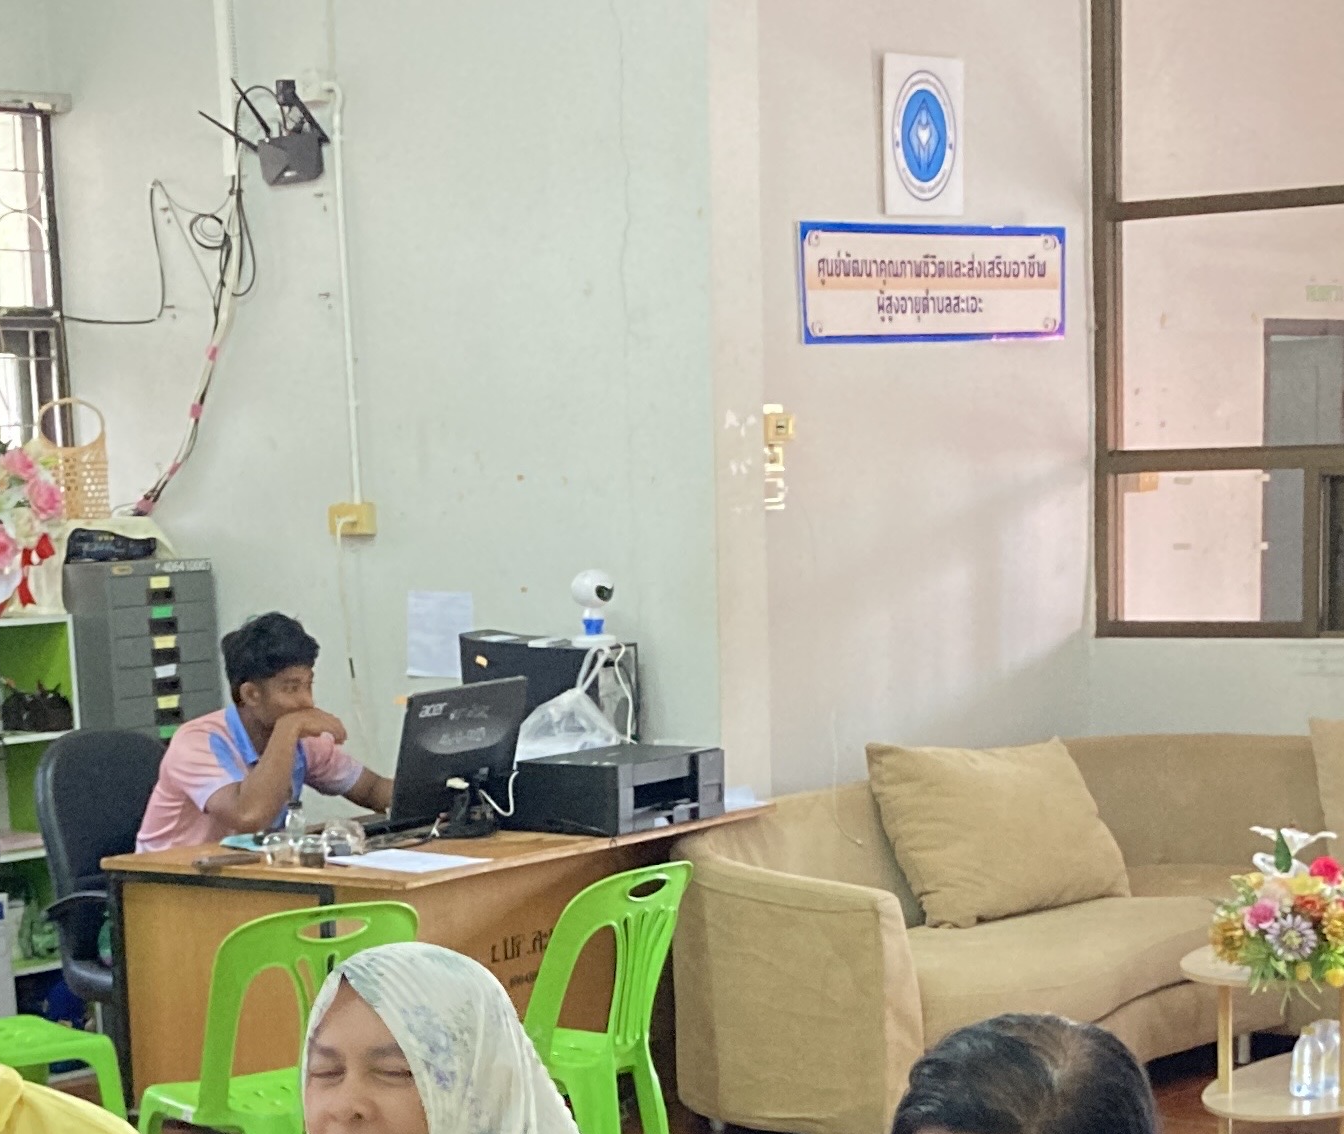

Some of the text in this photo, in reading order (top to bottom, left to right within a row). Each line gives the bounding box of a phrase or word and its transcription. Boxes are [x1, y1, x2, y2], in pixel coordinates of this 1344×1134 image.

[817, 249, 1047, 286] ศูนย์พัฒนาคุณภาพชีวิตและส่งเสริมอาชีพ
[418, 702, 448, 718] acer
